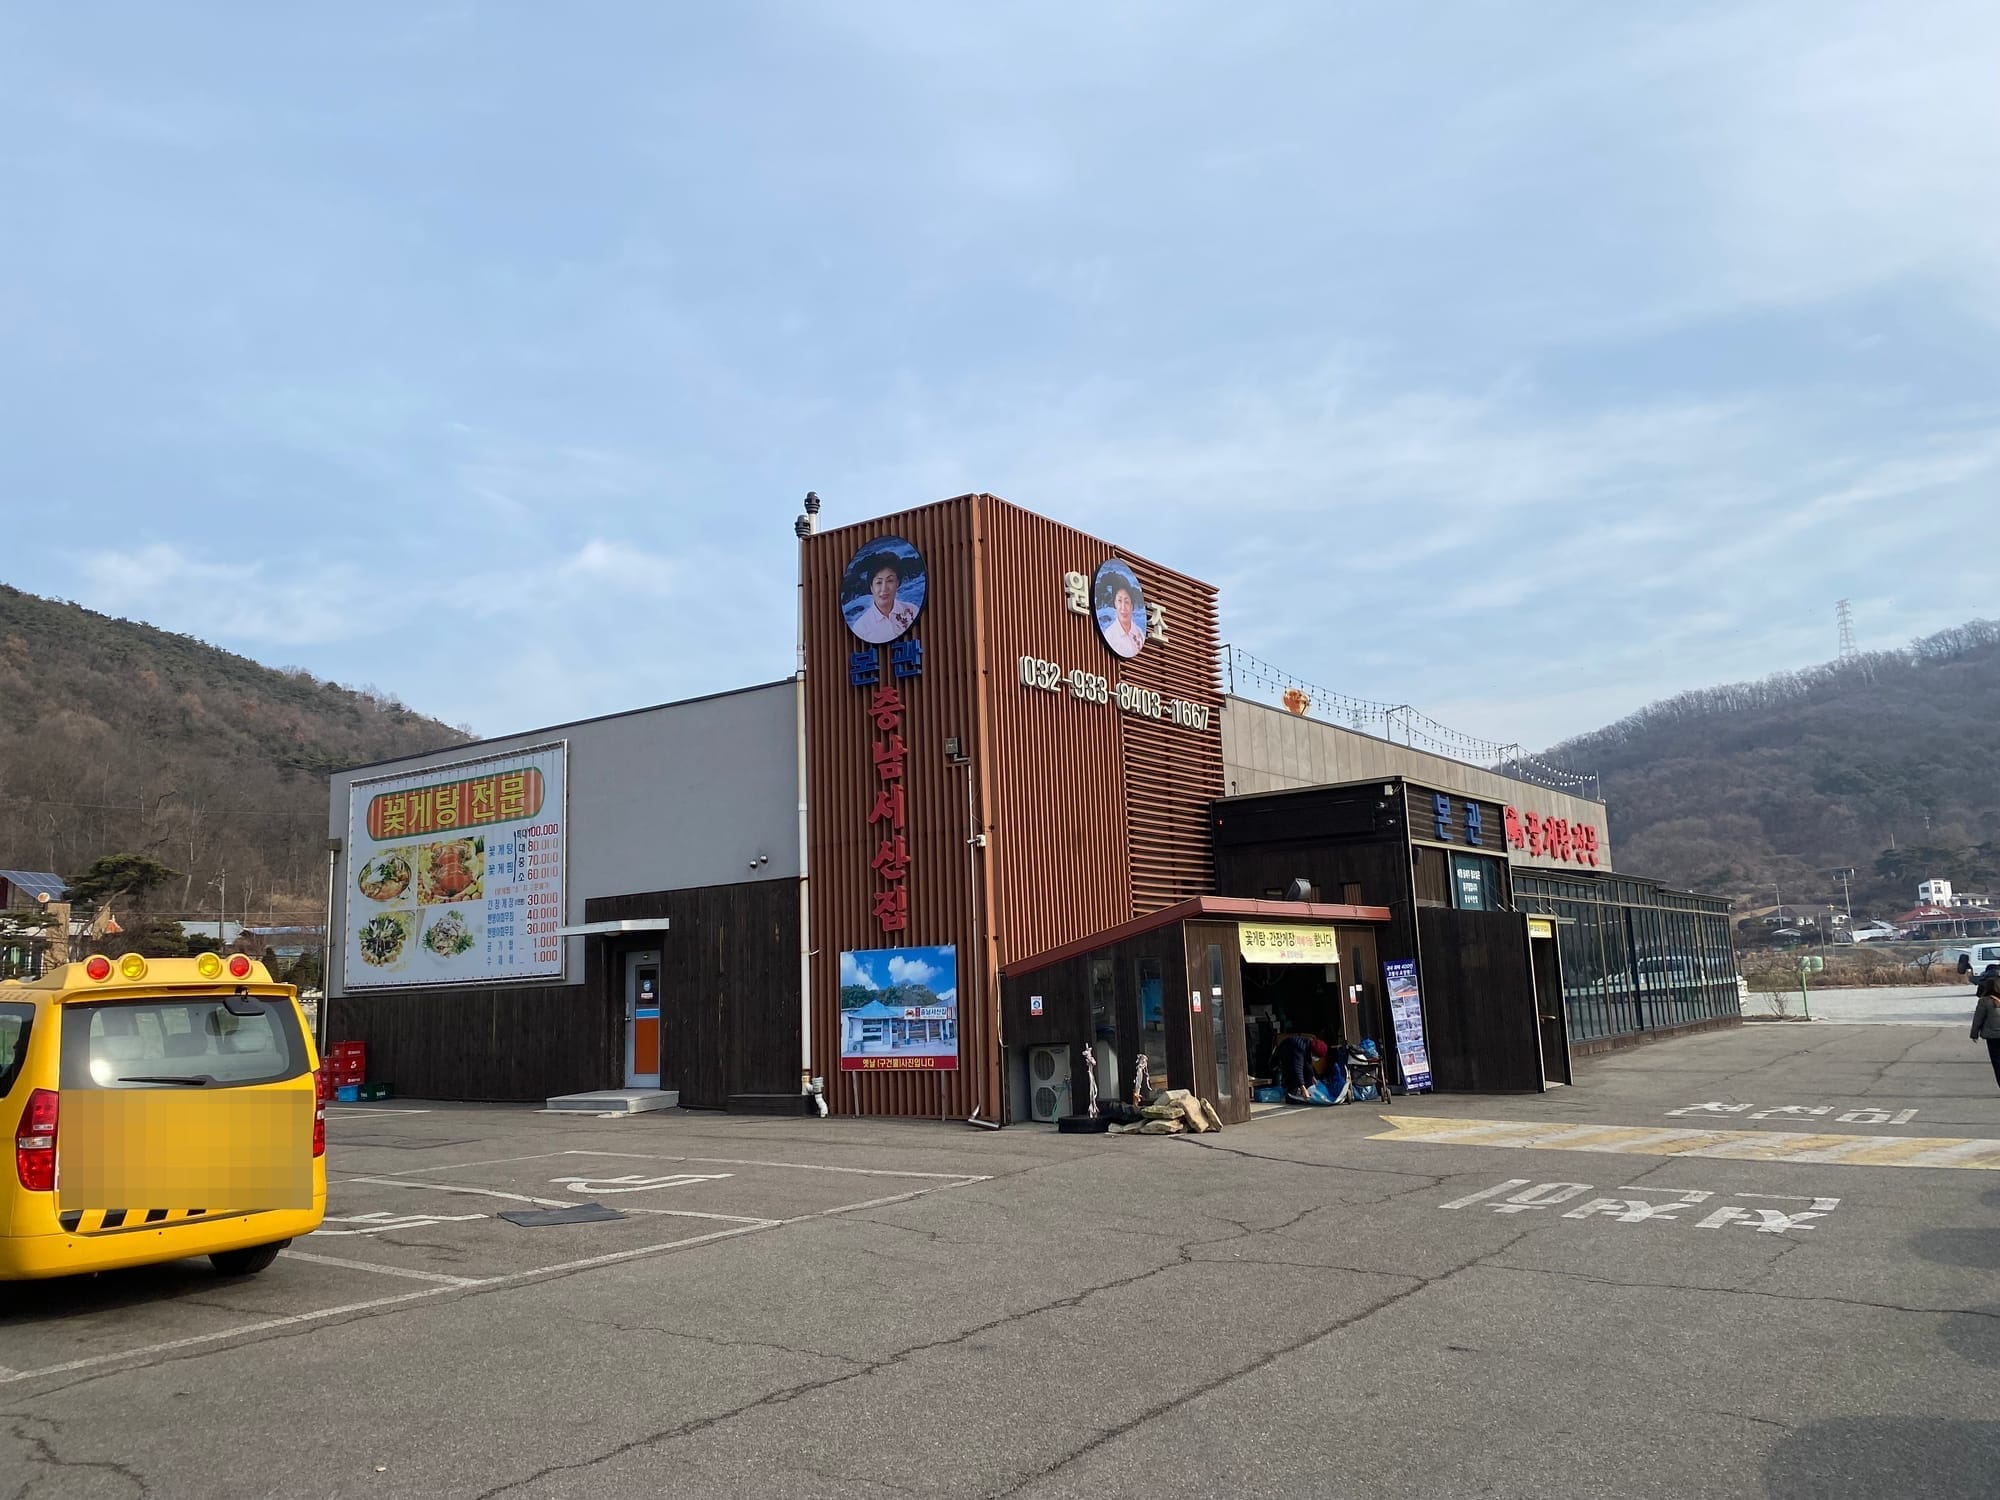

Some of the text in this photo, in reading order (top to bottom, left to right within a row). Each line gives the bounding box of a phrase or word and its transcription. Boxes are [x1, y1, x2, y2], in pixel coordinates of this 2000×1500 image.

[1064, 571, 1169, 643] 원 조
[850, 639, 924, 685] 본관
[1020, 655, 1209, 730] 032-933-8403~1667
[383, 775, 525, 833] 꽃게탕 전문
[868, 686, 910, 932] 충남서산집
[1664, 1101, 1919, 1125] 천천히
